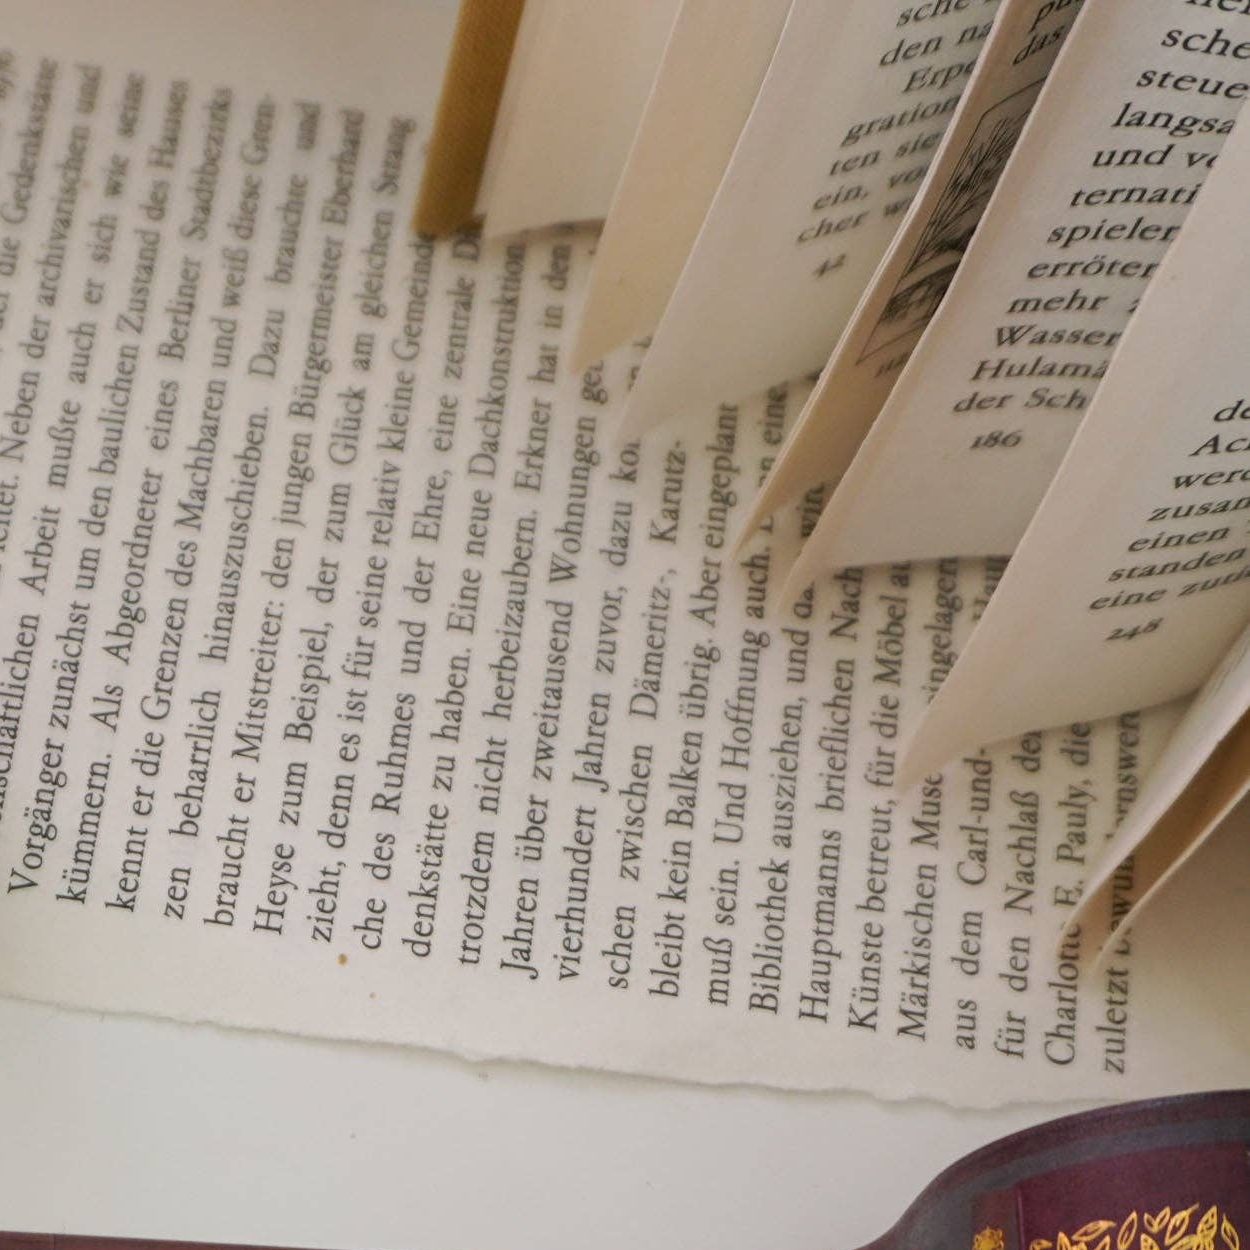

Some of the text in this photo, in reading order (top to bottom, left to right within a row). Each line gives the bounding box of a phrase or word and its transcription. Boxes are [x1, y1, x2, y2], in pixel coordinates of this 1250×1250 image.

[878, 36, 944, 67] den
[1092, 144, 1176, 169] und
[1006, 288, 1108, 314] mehr
[19, 315, 49, 359] der
[953, 390, 1014, 413] der
[968, 429, 1023, 450] 186
[1128, 527, 1230, 552] einen
[1089, 589, 1167, 610] eine
[103, 380, 226, 912] kennt er die Grenzen des Machbaren
[252, 386, 366, 935] Heyse zum Beispiel, der zum Glück
[400, 489, 492, 957] denkstätte zu haben. Eine neue
[600, 441, 686, 989] schen zwischen Dämeritz-, Karutz-
[846, 594, 907, 1032] Künste betreut, für die Möbel
